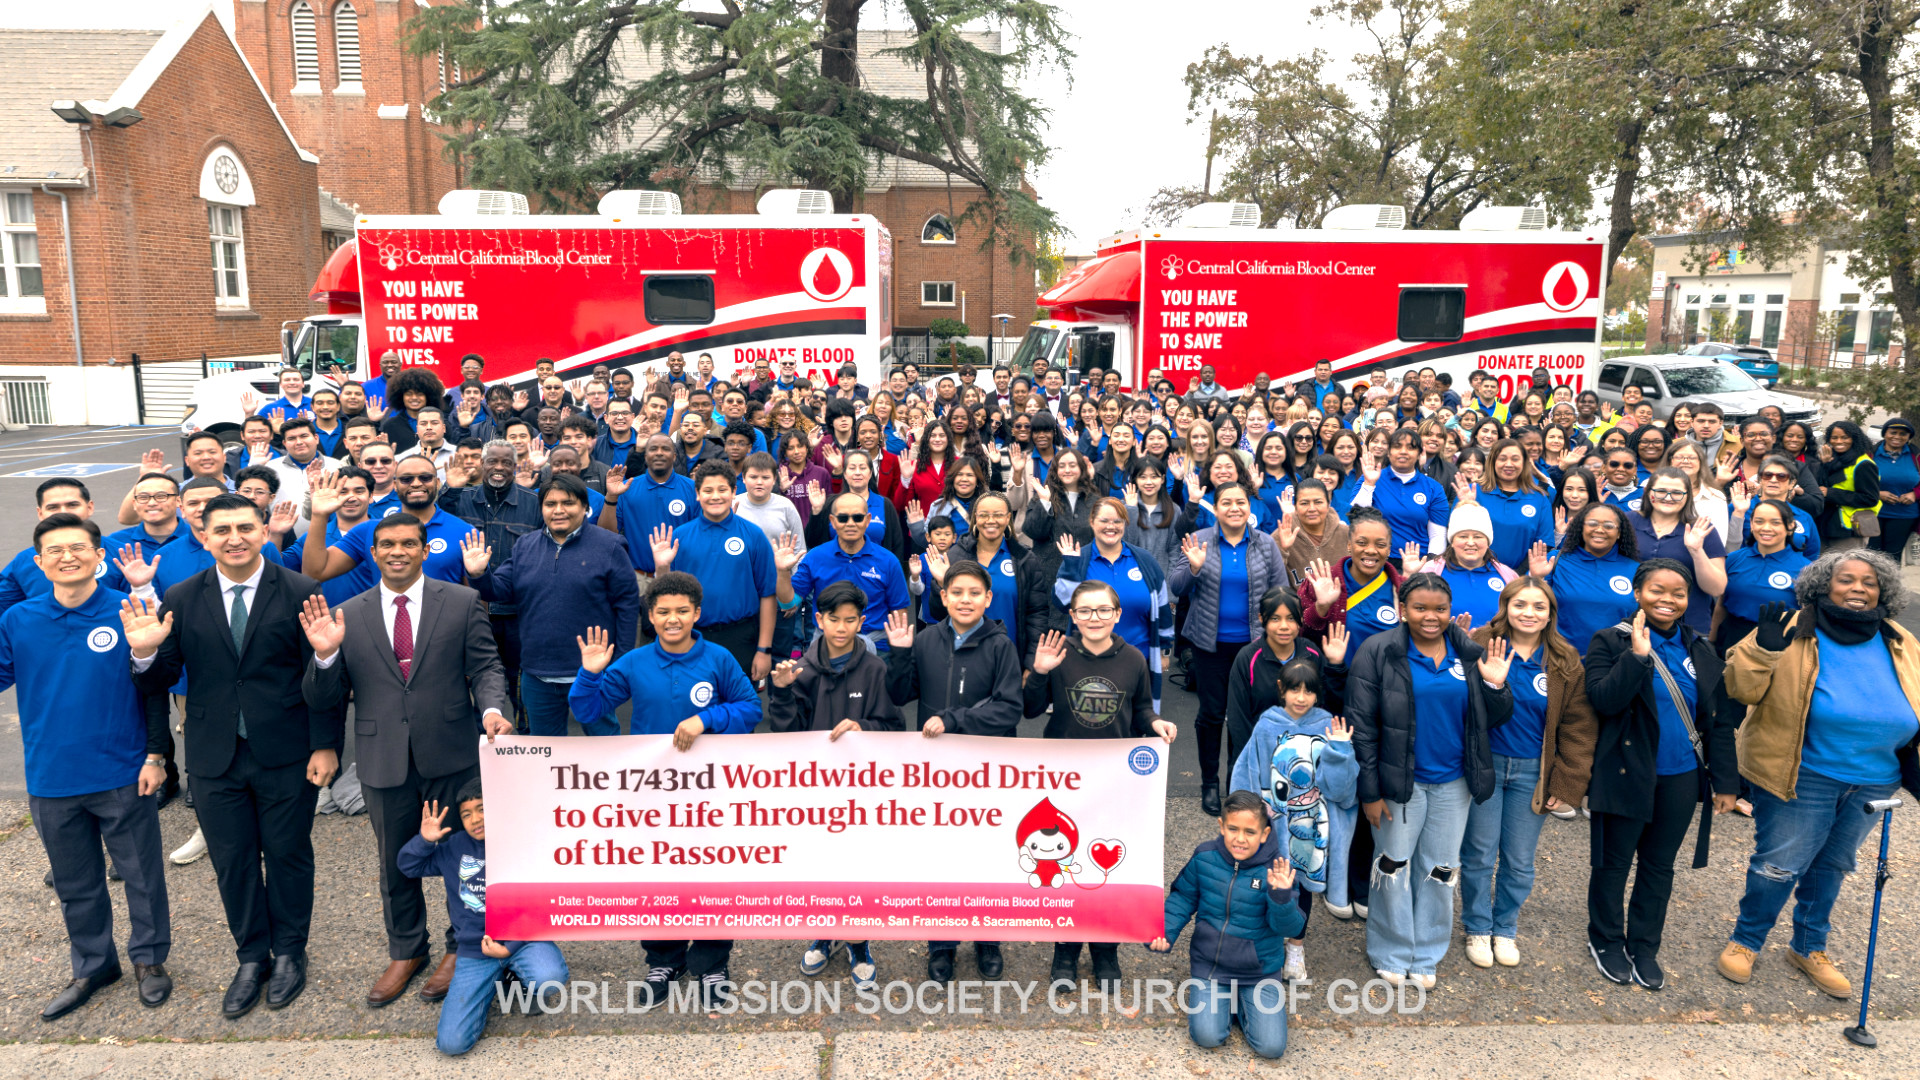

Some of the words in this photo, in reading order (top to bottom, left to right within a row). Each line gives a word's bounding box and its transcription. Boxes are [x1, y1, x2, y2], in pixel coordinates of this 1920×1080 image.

[407, 249, 458, 265] Central
[459, 249, 526, 265] California
[526, 249, 563, 266] Blood
[566, 249, 612, 265] Center
[1187, 259, 1235, 275] Central
[1236, 259, 1295, 275] California
[1296, 260, 1333, 275] Blood
[1334, 261, 1376, 276] Center
[381, 280, 417, 298] YOU
[421, 280, 465, 298] HAVE
[1161, 289, 1193, 306] YOU
[1197, 289, 1238, 306] HAVE
[383, 303, 418, 321] THE
[420, 303, 479, 321] POWER
[1160, 311, 1190, 328] THE
[1195, 311, 1248, 328] POWER
[385, 325, 408, 343] TO
[411, 325, 455, 343] SAVE
[1159, 333, 1180, 350] TO
[1184, 333, 1223, 350] SAVE
[387, 348, 440, 365] IVES.
[734, 347, 797, 364] DONATE
[802, 347, 855, 364] BLOOD
[1478, 354, 1534, 370] DONATE
[1538, 354, 1585, 370] BLOOD
[848, 691, 863, 699] FILA
[1070, 690, 1119, 713] VANS
[495, 744, 552, 757] watv.org
[551, 764, 609, 790] The
[616, 763, 716, 792] 1743rd
[722, 761, 895, 789] Worldwide
[903, 761, 991, 788] Blood
[999, 764, 1081, 790] Drive
[553, 805, 586, 828] to
[593, 803, 661, 828] Give
[667, 801, 724, 827] Life
[730, 799, 867, 834] Through
[875, 800, 927, 826] the
[933, 802, 1003, 827] Love
[553, 840, 586, 865] of
[592, 840, 645, 865] the
[652, 840, 787, 865] Passover
[466, 883, 486, 892] Hurle
[558, 895, 585, 906] Date:
[587, 895, 639, 906] December
[641, 895, 651, 908] 7,
[653, 895, 680, 906] 2025
[699, 895, 733, 906] Venue:
[735, 894, 771, 906] Church
[773, 894, 783, 906] of
[785, 894, 808, 908] God,
[811, 895, 846, 908] Fresno,
[848, 895, 863, 906] CA
[882, 895, 924, 908] Support:
[926, 895, 961, 907] Central
[963, 895, 1010, 907] California
[1012, 896, 1040, 907] Blood
[1042, 896, 1076, 908] Center
[549, 914, 601, 926] WORLD
[604, 914, 660, 926] MISSION
[663, 914, 722, 926] SOCIETY
[724, 914, 782, 927] CHURCH
[784, 914, 803, 926] OF
[806, 915, 837, 927] GOD
[842, 915, 886, 928] Fresno,
[887, 915, 910, 927] San
[912, 915, 969, 927] Francisco
[971, 916, 981, 927] &
[982, 916, 1054, 929] Sacramento,
[1056, 916, 1075, 928] CA
